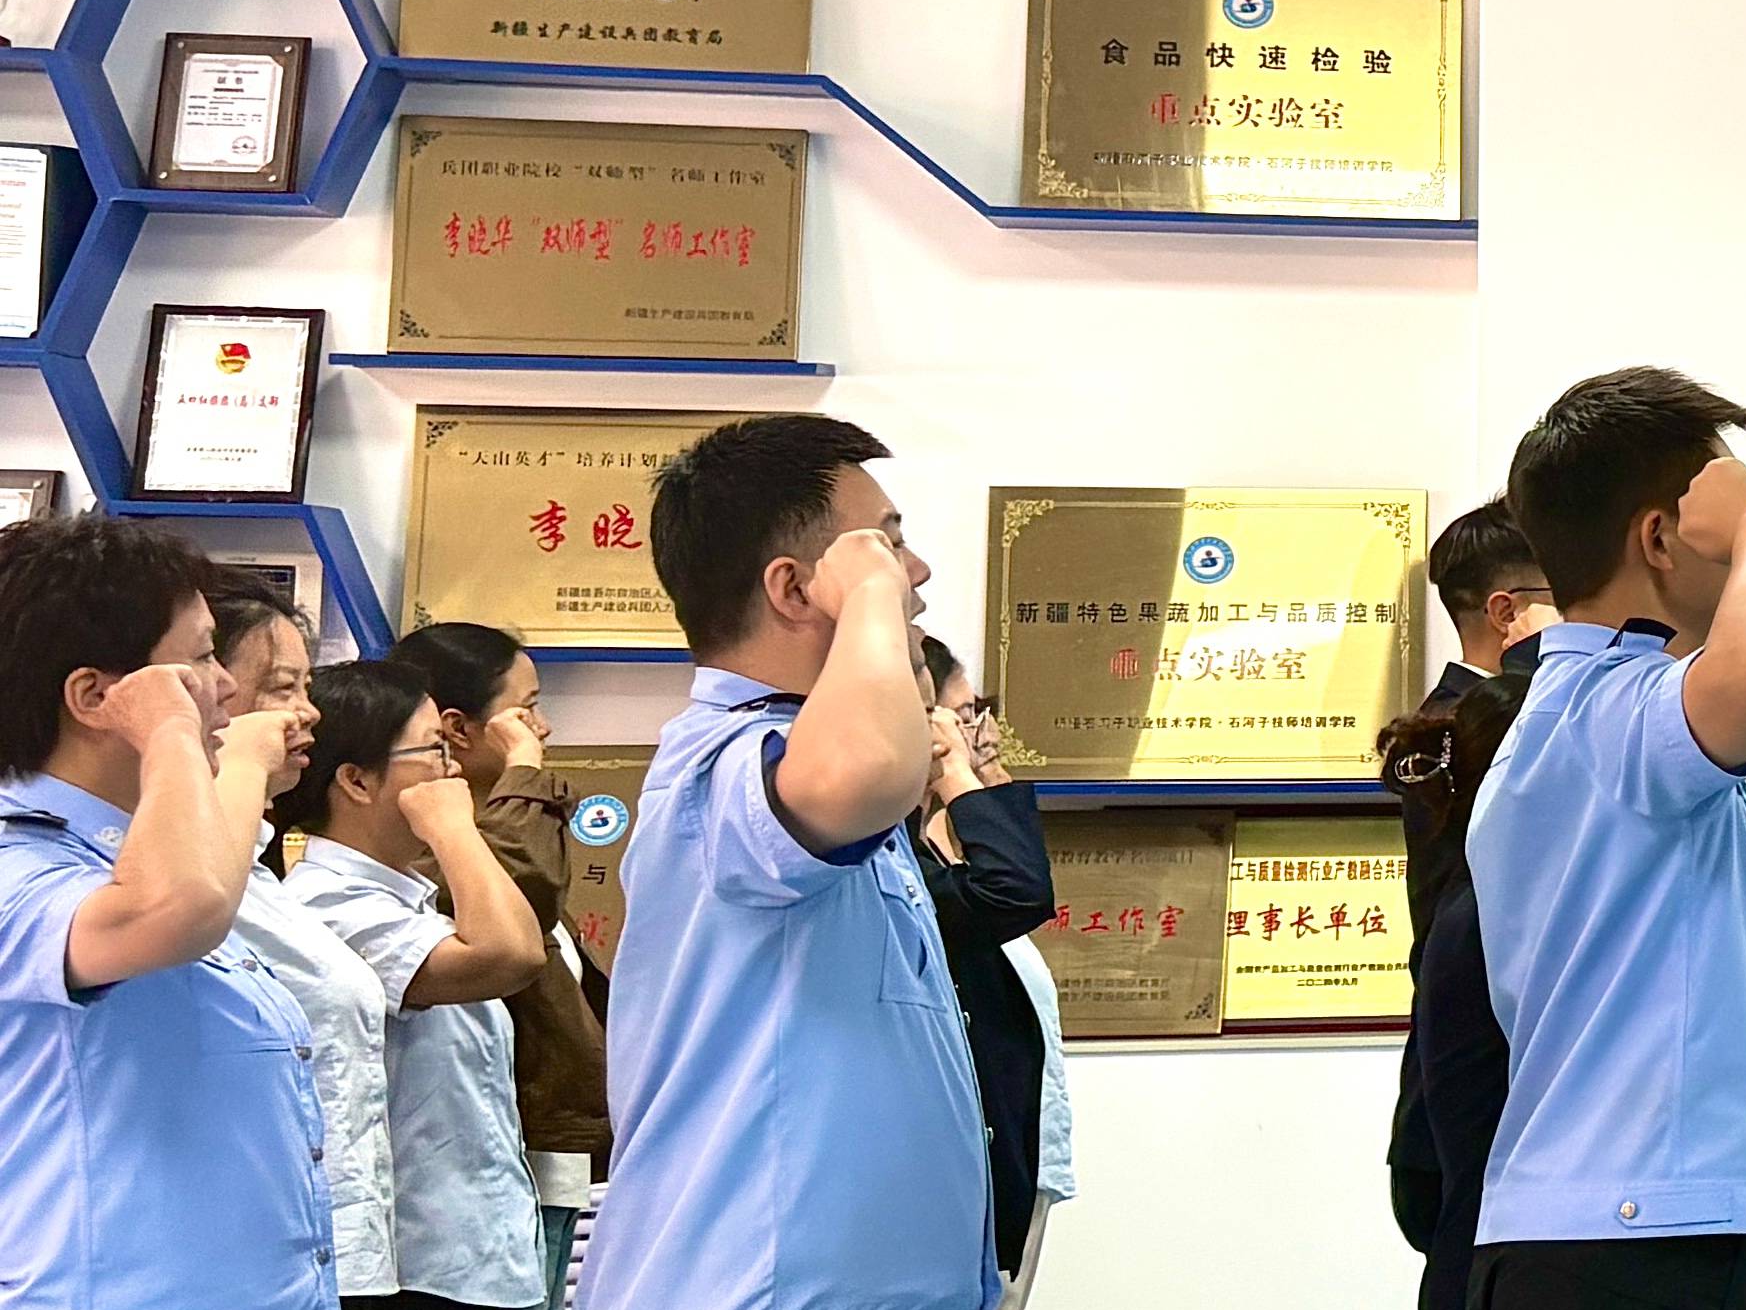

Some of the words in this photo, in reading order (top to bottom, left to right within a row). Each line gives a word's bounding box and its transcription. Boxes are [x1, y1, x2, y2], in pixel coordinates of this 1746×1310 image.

[490, 21, 723, 46] 新疆生产建设兵团教育局
[1101, 37, 1394, 76] 食品快速检验
[1150, 92, 1345, 131] 重点实验室
[1016, 601, 1398, 624] 新疆特色果蔬加工与品质控制
[1109, 648, 1307, 682] 重点实验室
[582, 864, 606, 884] 与
[1227, 902, 1388, 942] 理事长单位
